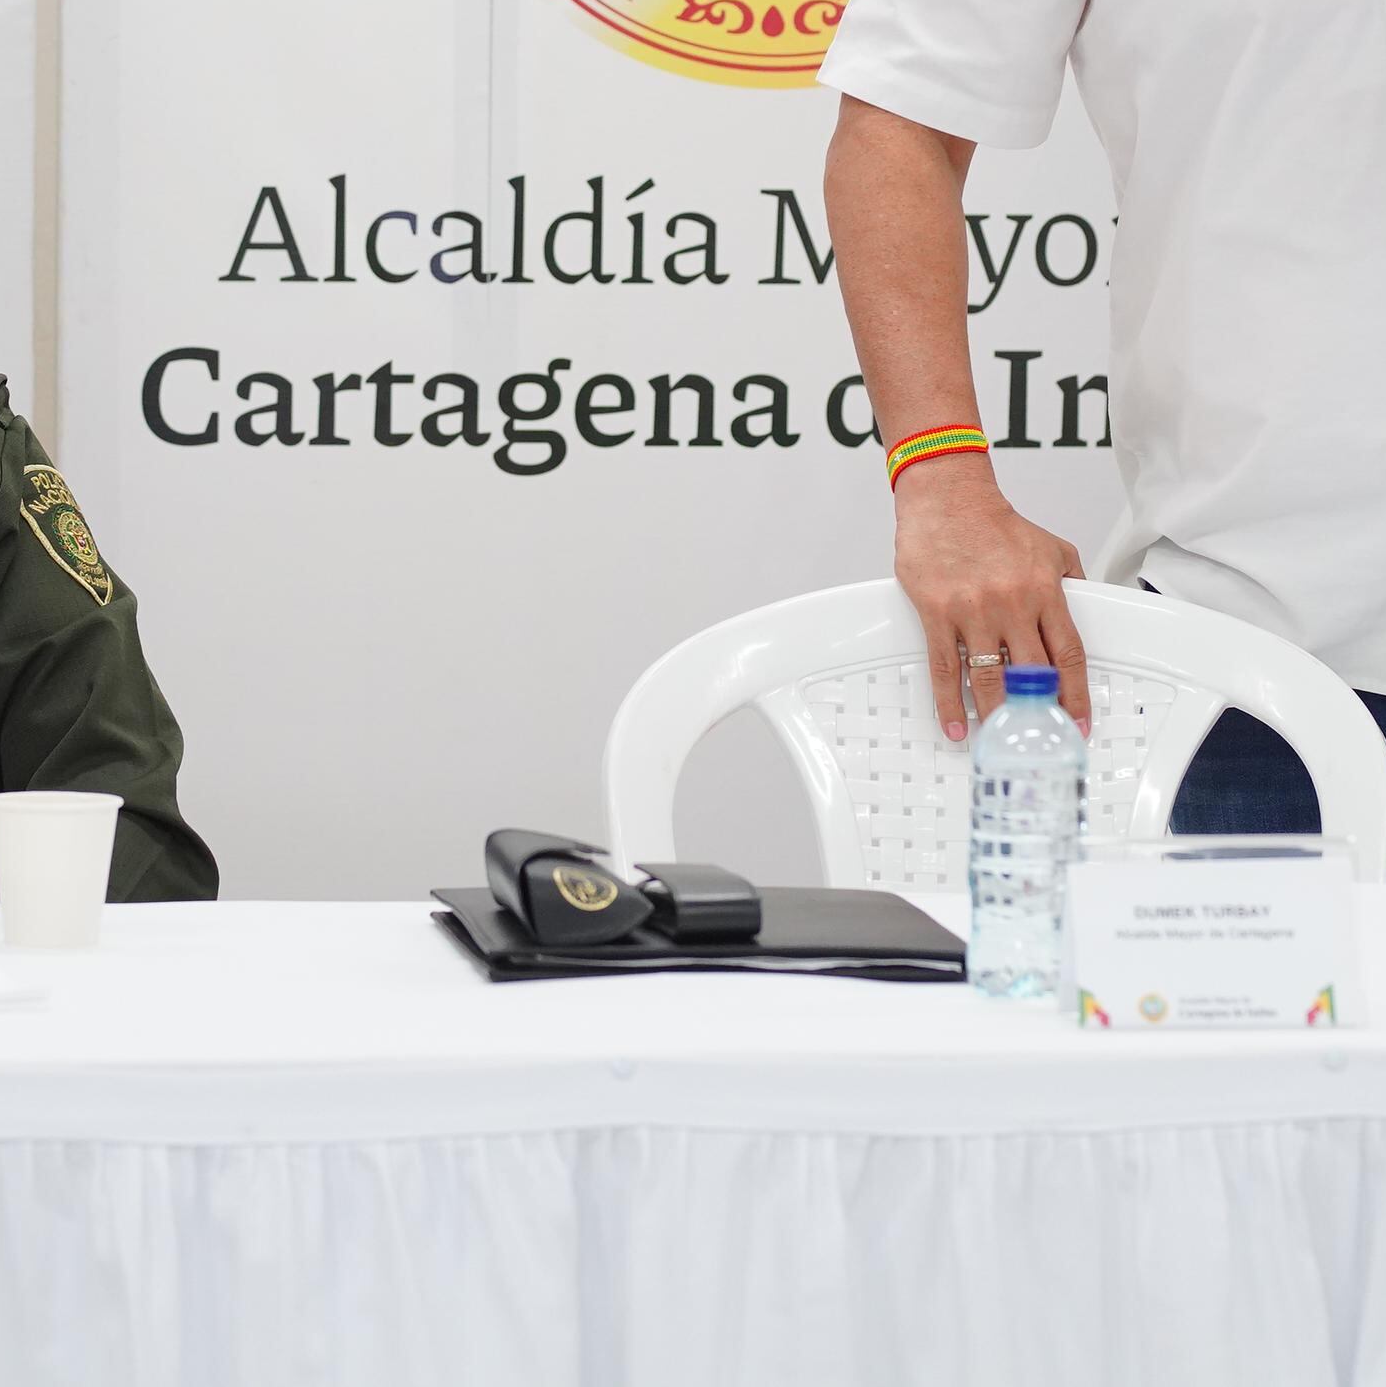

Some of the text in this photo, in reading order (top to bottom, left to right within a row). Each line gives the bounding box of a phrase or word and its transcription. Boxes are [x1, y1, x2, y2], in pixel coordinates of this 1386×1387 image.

[218, 174, 1120, 315] Alcaldía Myo
[141, 347, 801, 476] Cartagena
